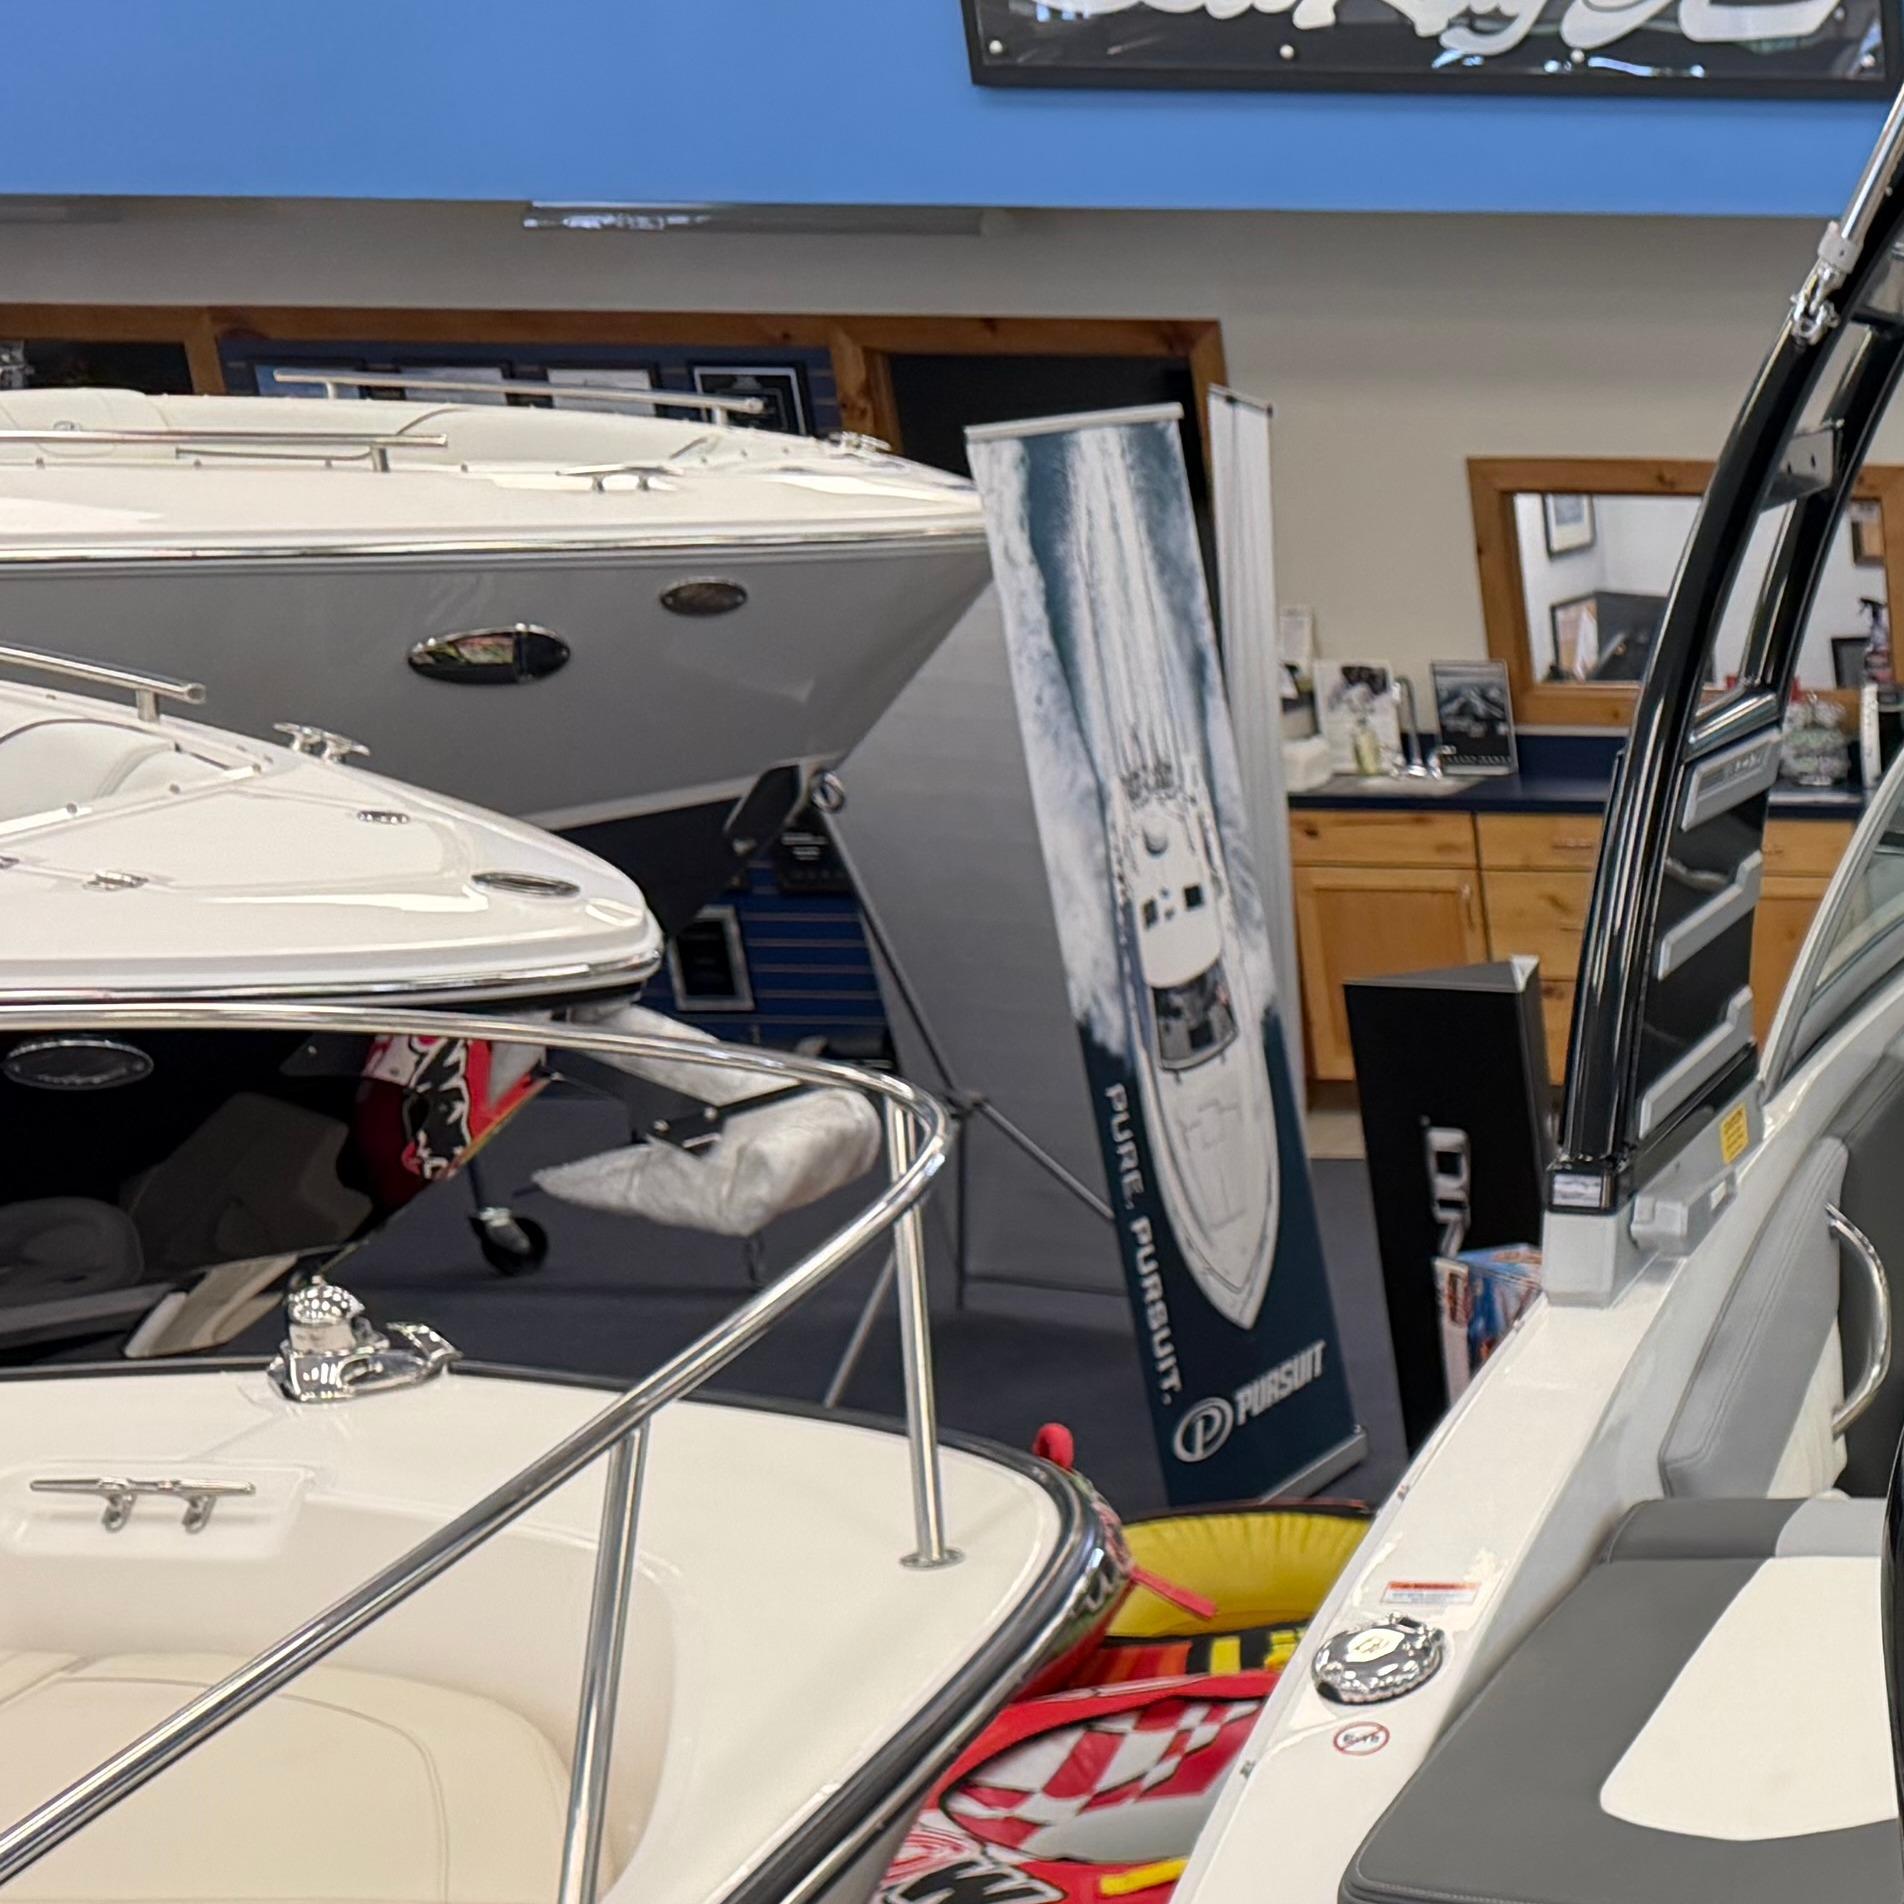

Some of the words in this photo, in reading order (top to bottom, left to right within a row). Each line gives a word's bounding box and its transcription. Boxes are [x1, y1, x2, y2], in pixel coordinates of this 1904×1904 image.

[1105, 1082, 1145, 1210] PURE.
[1130, 1216, 1183, 1405] PURSUIT.
[1234, 1340, 1327, 1426] PURSUIT
